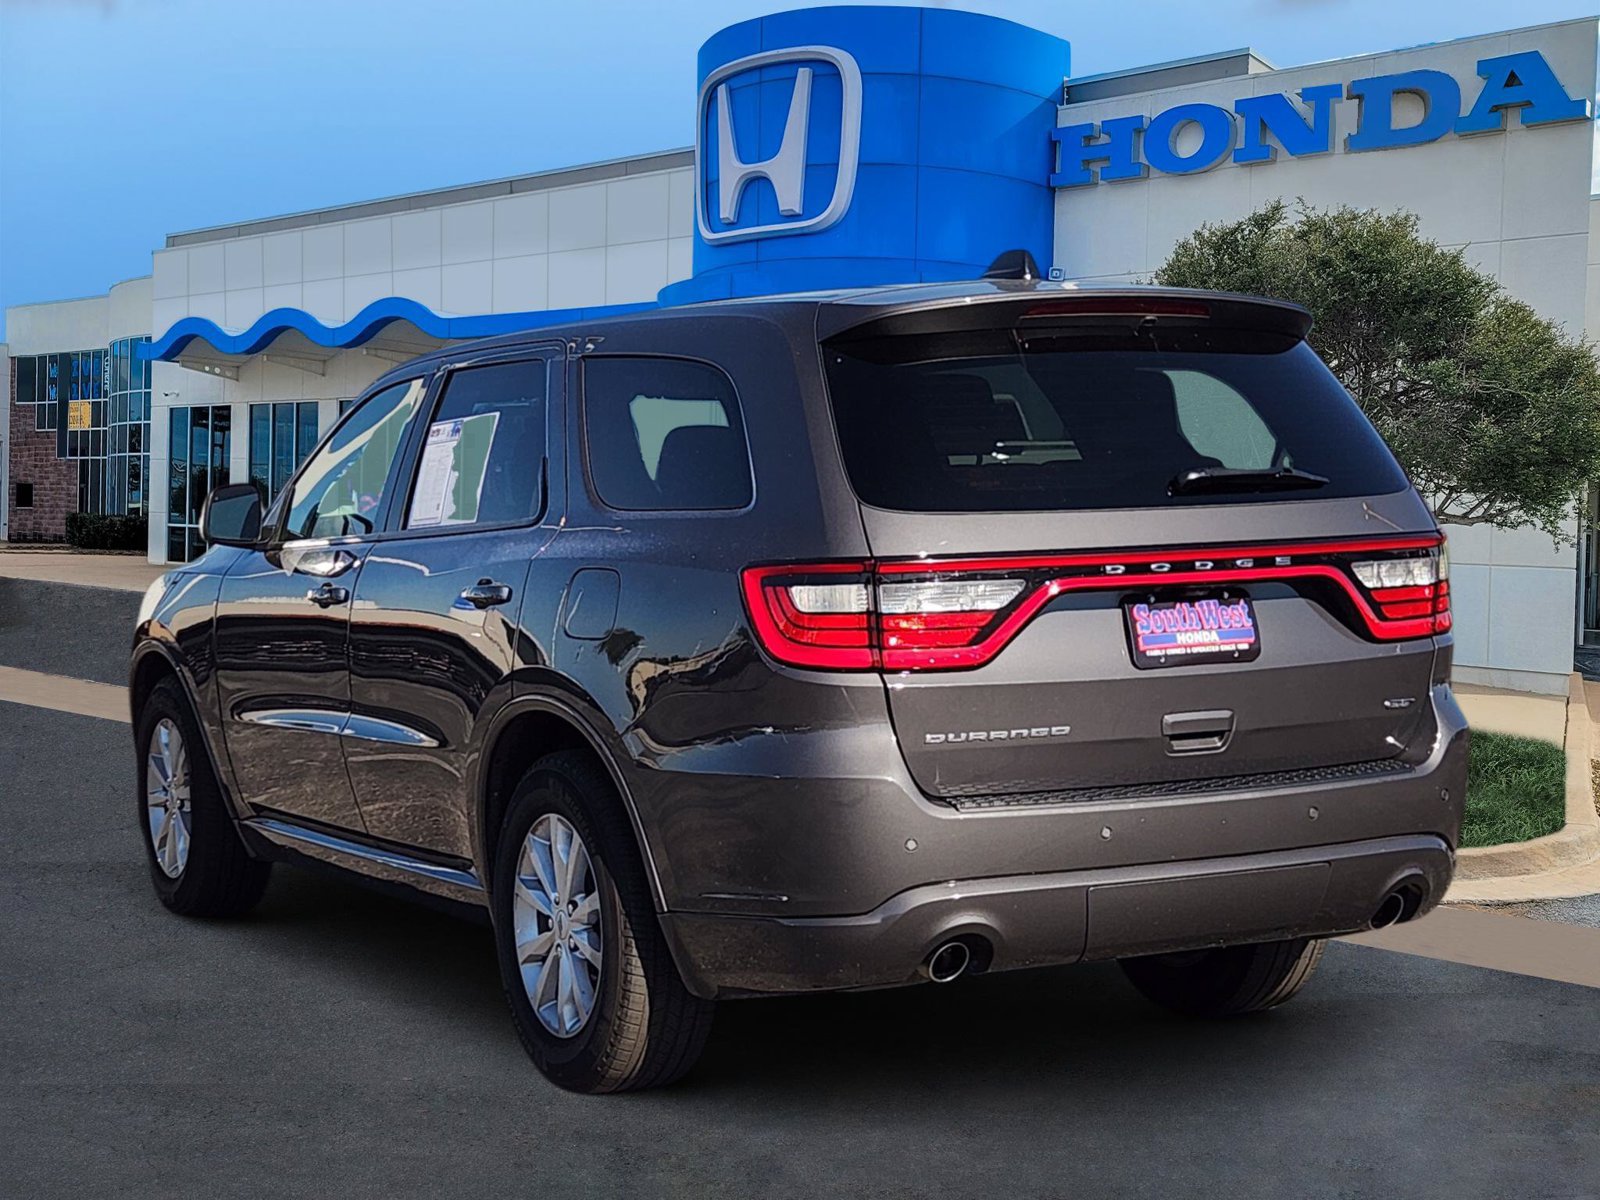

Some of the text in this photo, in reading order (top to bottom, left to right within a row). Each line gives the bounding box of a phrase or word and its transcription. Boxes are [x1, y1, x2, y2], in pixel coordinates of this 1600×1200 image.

[1049, 49, 1592, 188] HONDA
[1104, 556, 1292, 575] DODGE
[1175, 629, 1220, 645] HONDA
[924, 725, 1072, 744] DURANGO
